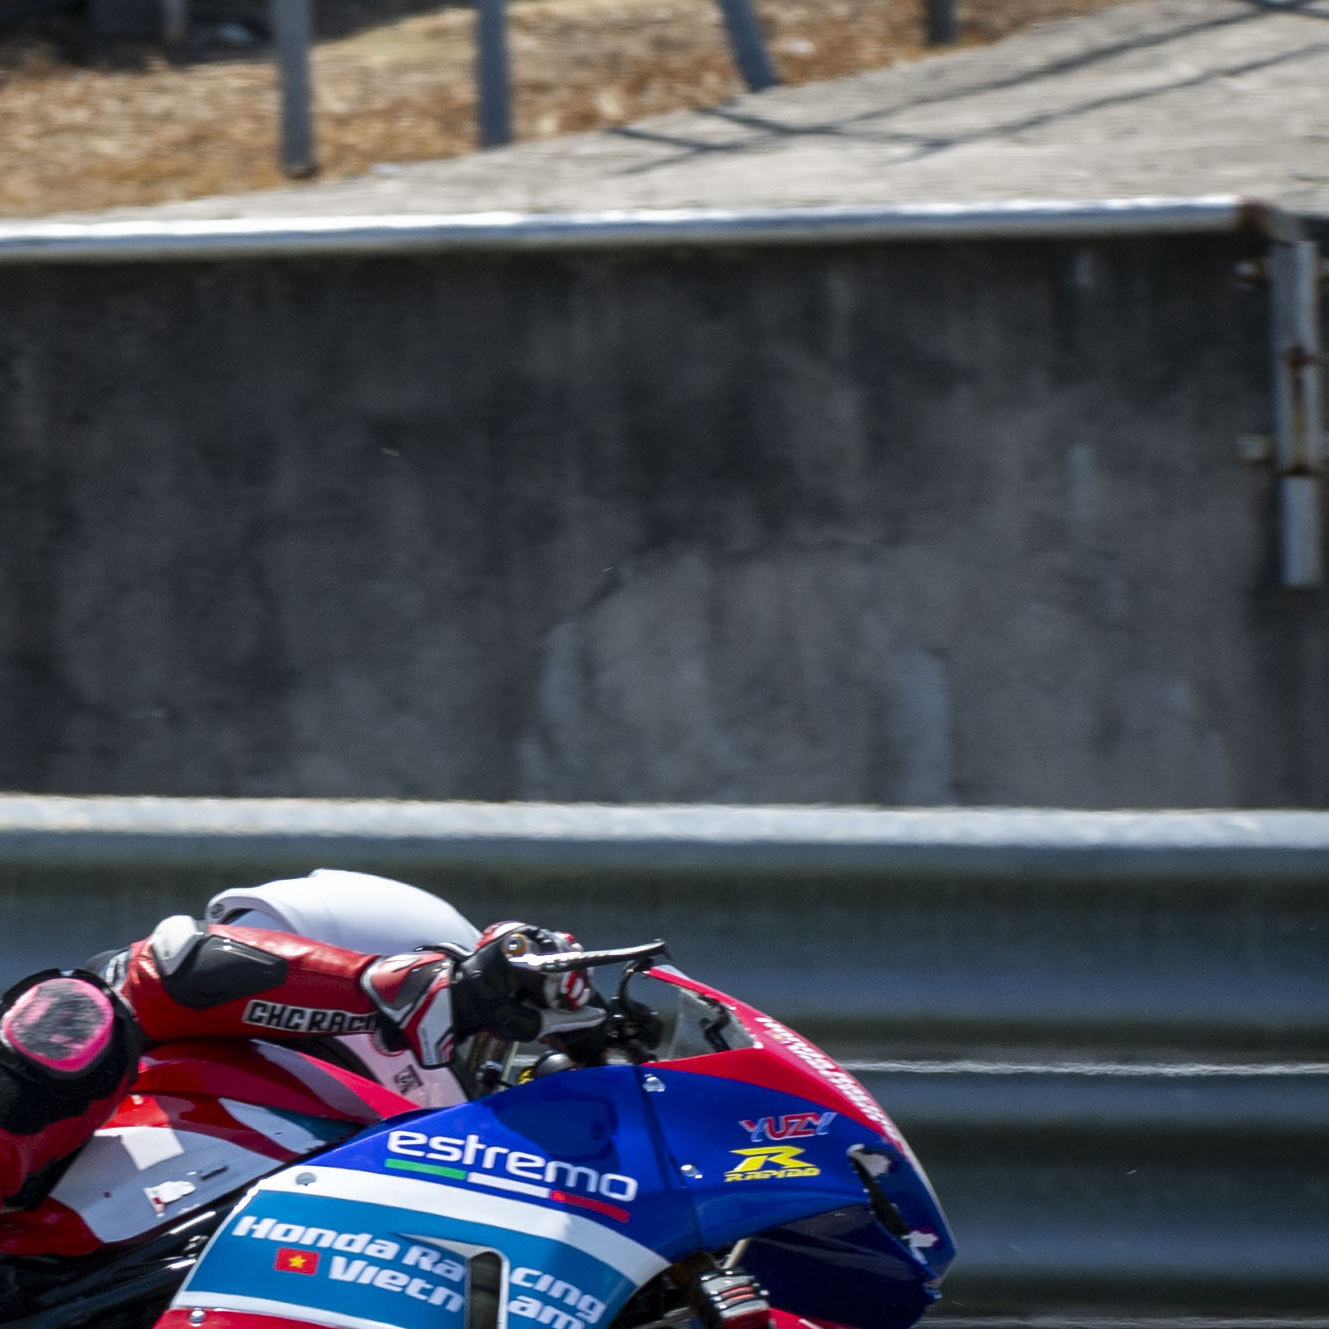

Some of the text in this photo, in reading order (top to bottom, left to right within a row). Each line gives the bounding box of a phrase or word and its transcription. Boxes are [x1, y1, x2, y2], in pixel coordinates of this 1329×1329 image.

[737, 1111, 838, 1142] YUZY
[386, 1129, 639, 1203] estremo
[723, 1167, 821, 1182] RAPIDO
[231, 1214, 399, 1261] Honda
